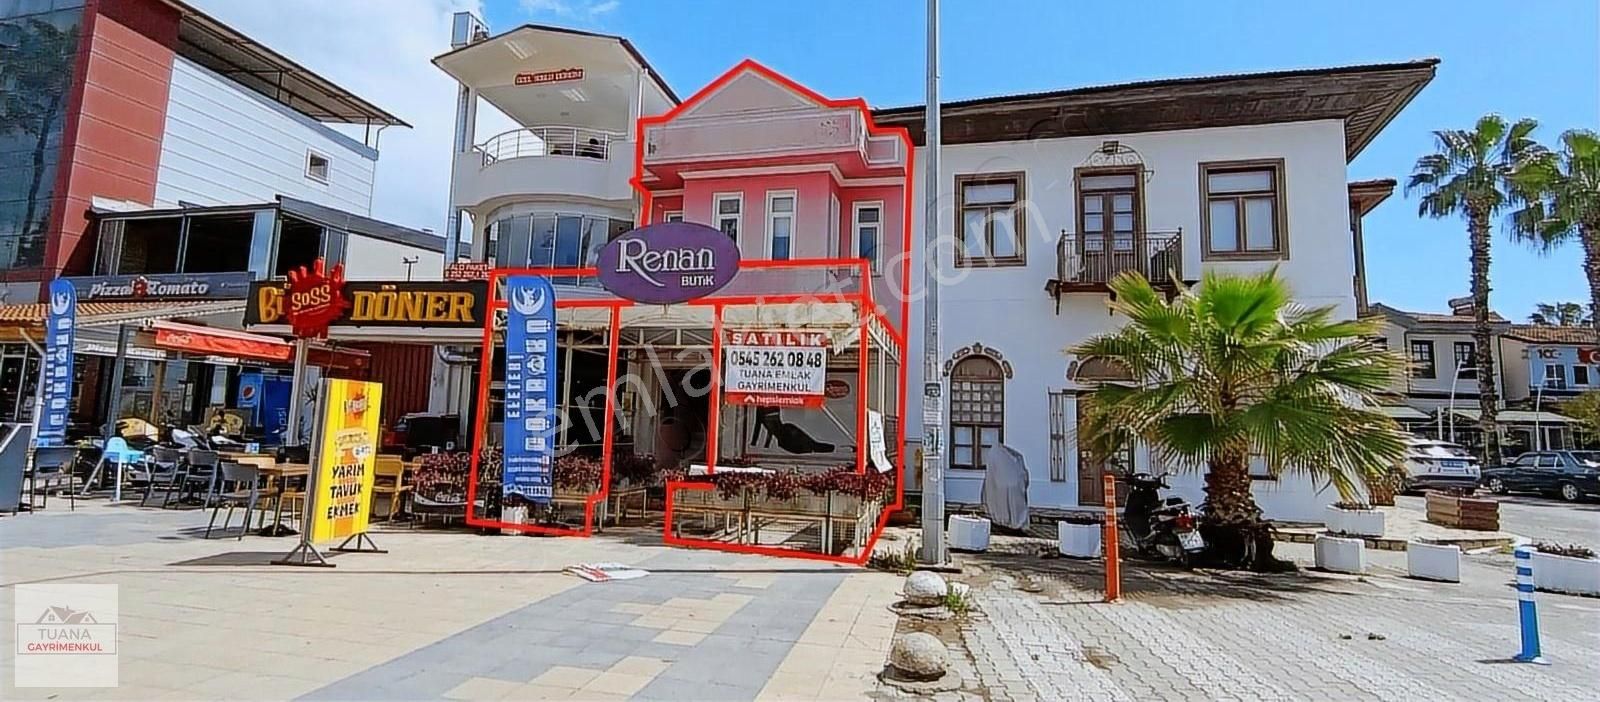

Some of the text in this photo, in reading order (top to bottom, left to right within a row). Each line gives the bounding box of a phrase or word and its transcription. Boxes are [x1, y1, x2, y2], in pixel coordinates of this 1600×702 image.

[615, 238, 715, 286] Renan
[350, 284, 475, 323] DÖNER
[732, 333, 821, 346] SATILIK
[730, 350, 822, 368] 0545 262 08 48
[740, 369, 811, 380] TUANA EMLAK
[332, 463, 364, 479] YARIM
[330, 483, 363, 499] TAVUK
[327, 503, 359, 519] EKMEK
